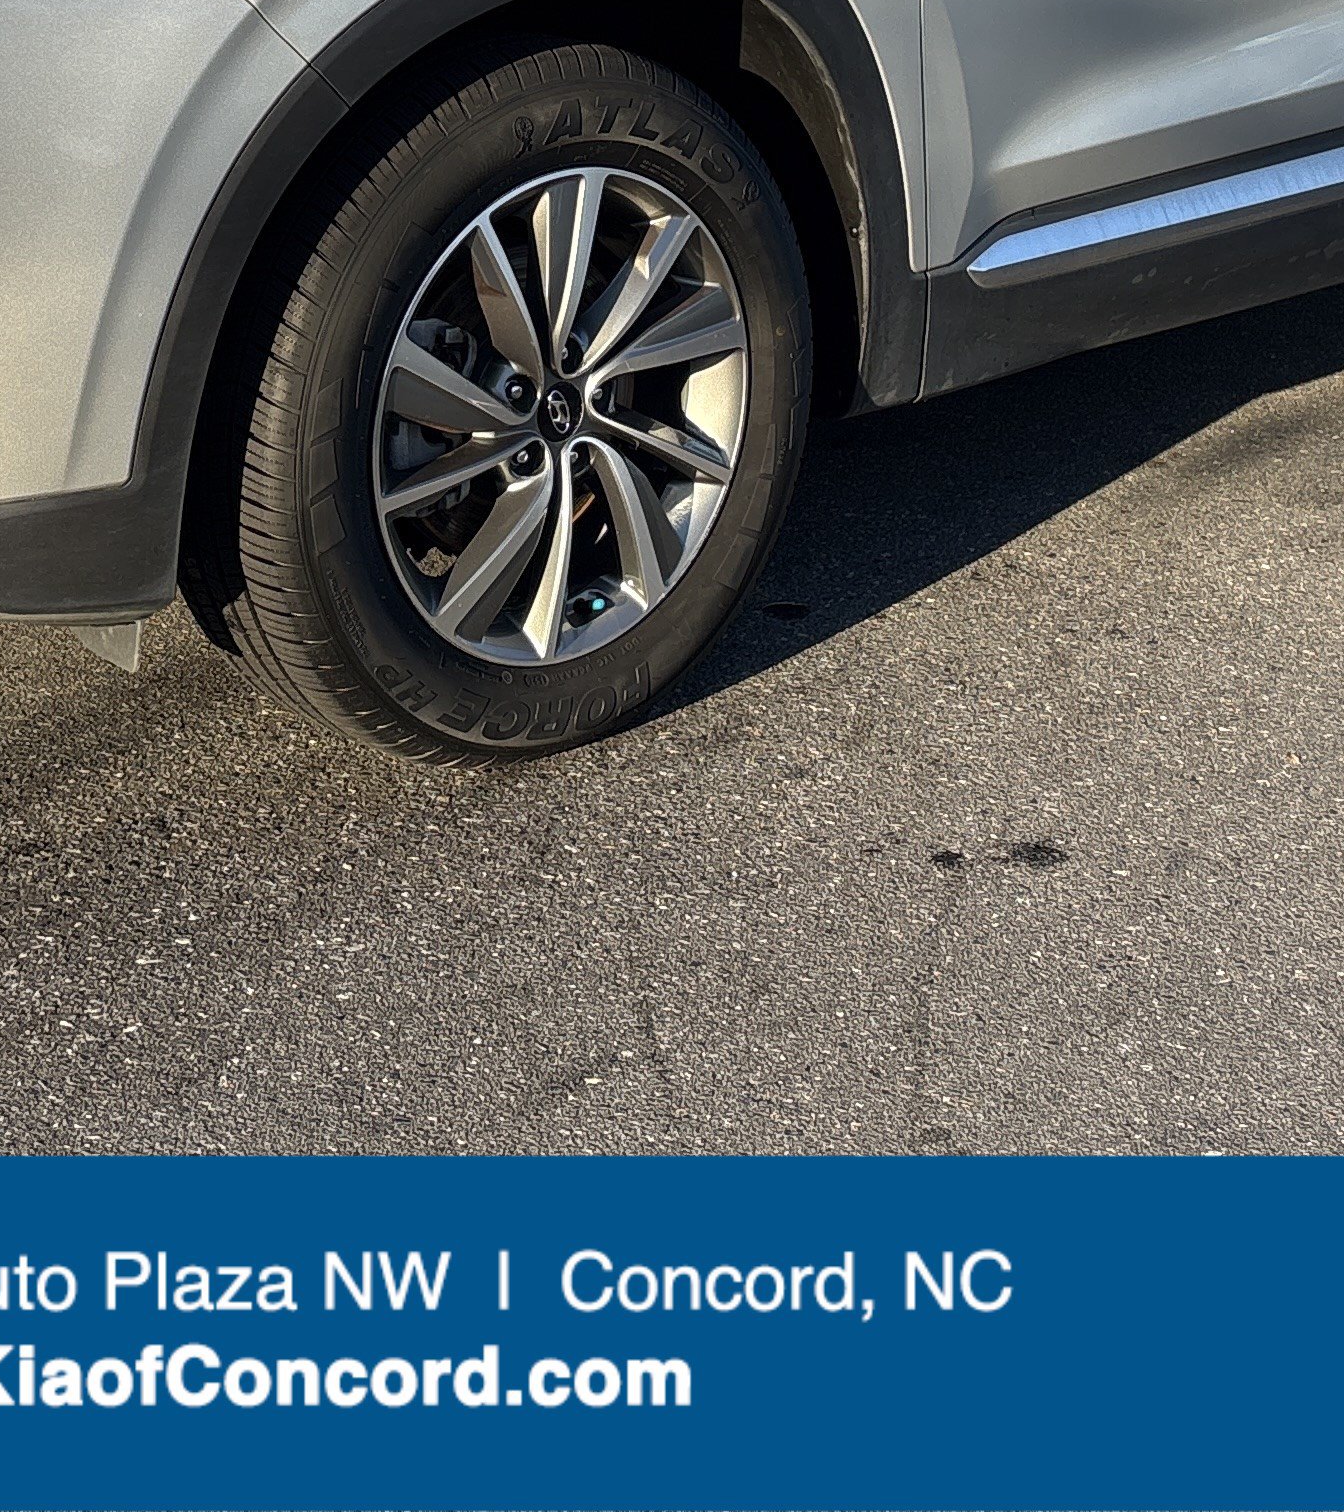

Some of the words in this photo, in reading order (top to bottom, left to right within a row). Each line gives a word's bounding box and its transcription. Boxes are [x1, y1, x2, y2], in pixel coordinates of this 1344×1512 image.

[543, 97, 743, 184] ATLAS
[374, 664, 438, 713] HP
[437, 660, 652, 741] FORCE
